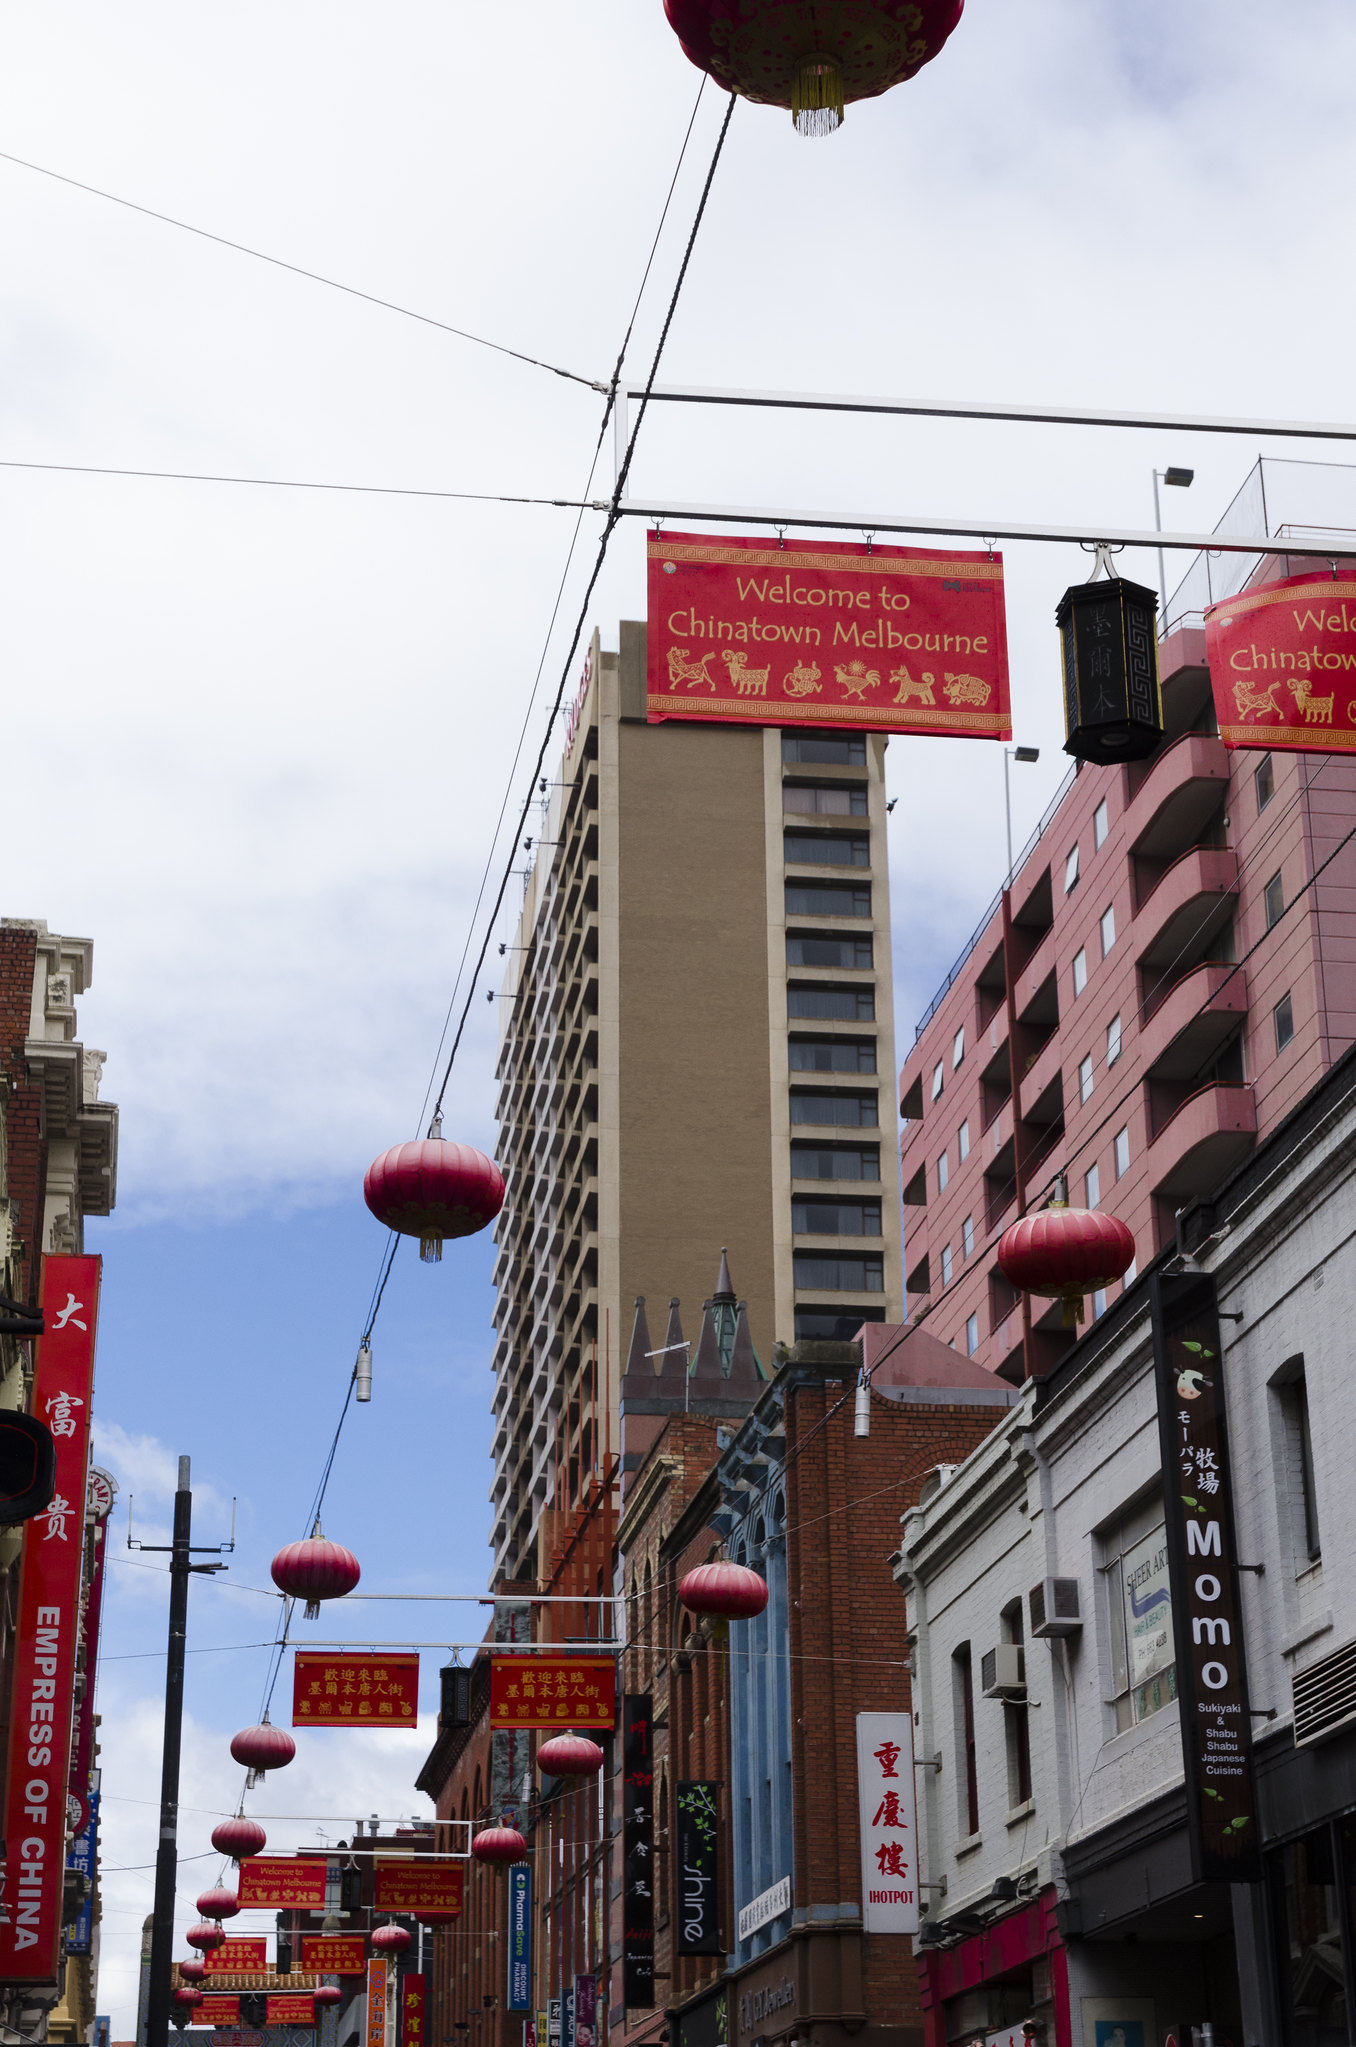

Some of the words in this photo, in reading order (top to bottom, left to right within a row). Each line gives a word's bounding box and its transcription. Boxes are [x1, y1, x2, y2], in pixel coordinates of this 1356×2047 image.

[736, 574, 871, 610] Welcome
[879, 586, 910, 611] to
[667, 607, 821, 646] Chinatown
[832, 619, 989, 654] Melbourne
[1177, 1411, 1194, 1476] モーパラ
[1194, 1447, 1220, 1495] 牧場
[1127, 1560, 1152, 1595] SHEER
[1186, 1519, 1231, 1690] Momo
[324, 1668, 389, 1683] 歡迎來臨
[520, 1670, 585, 1684] 歡迎來臨
[27, 1605, 60, 1767] EMPRESS
[307, 1682, 404, 1697] 墨爾本唐人街
[505, 1684, 600, 1698] 墨爾本唐人街
[1198, 1703, 1241, 1715] Sukiyaki
[1216, 1716, 1225, 1726] &
[1206, 1728, 1237, 1738] Shabu
[1207, 1741, 1238, 1751] Shabu
[1202, 1754, 1246, 1764] Japanese
[1206, 1765, 1243, 1775] Cuisine
[24, 1779, 49, 1825] OF
[871, 1741, 909, 1879] 重慶樓
[260, 1867, 294, 1876] Welcome
[397, 1871, 431, 1880] Welcome
[243, 1877, 281, 1886] Chinatown
[282, 1878, 322, 1887] Melbourne
[380, 1880, 418, 1890] Chinatown
[419, 1882, 459, 1891] Melbourne
[14, 1836, 46, 1952] CHINA
[516, 1890, 526, 1956] PharmaSave
